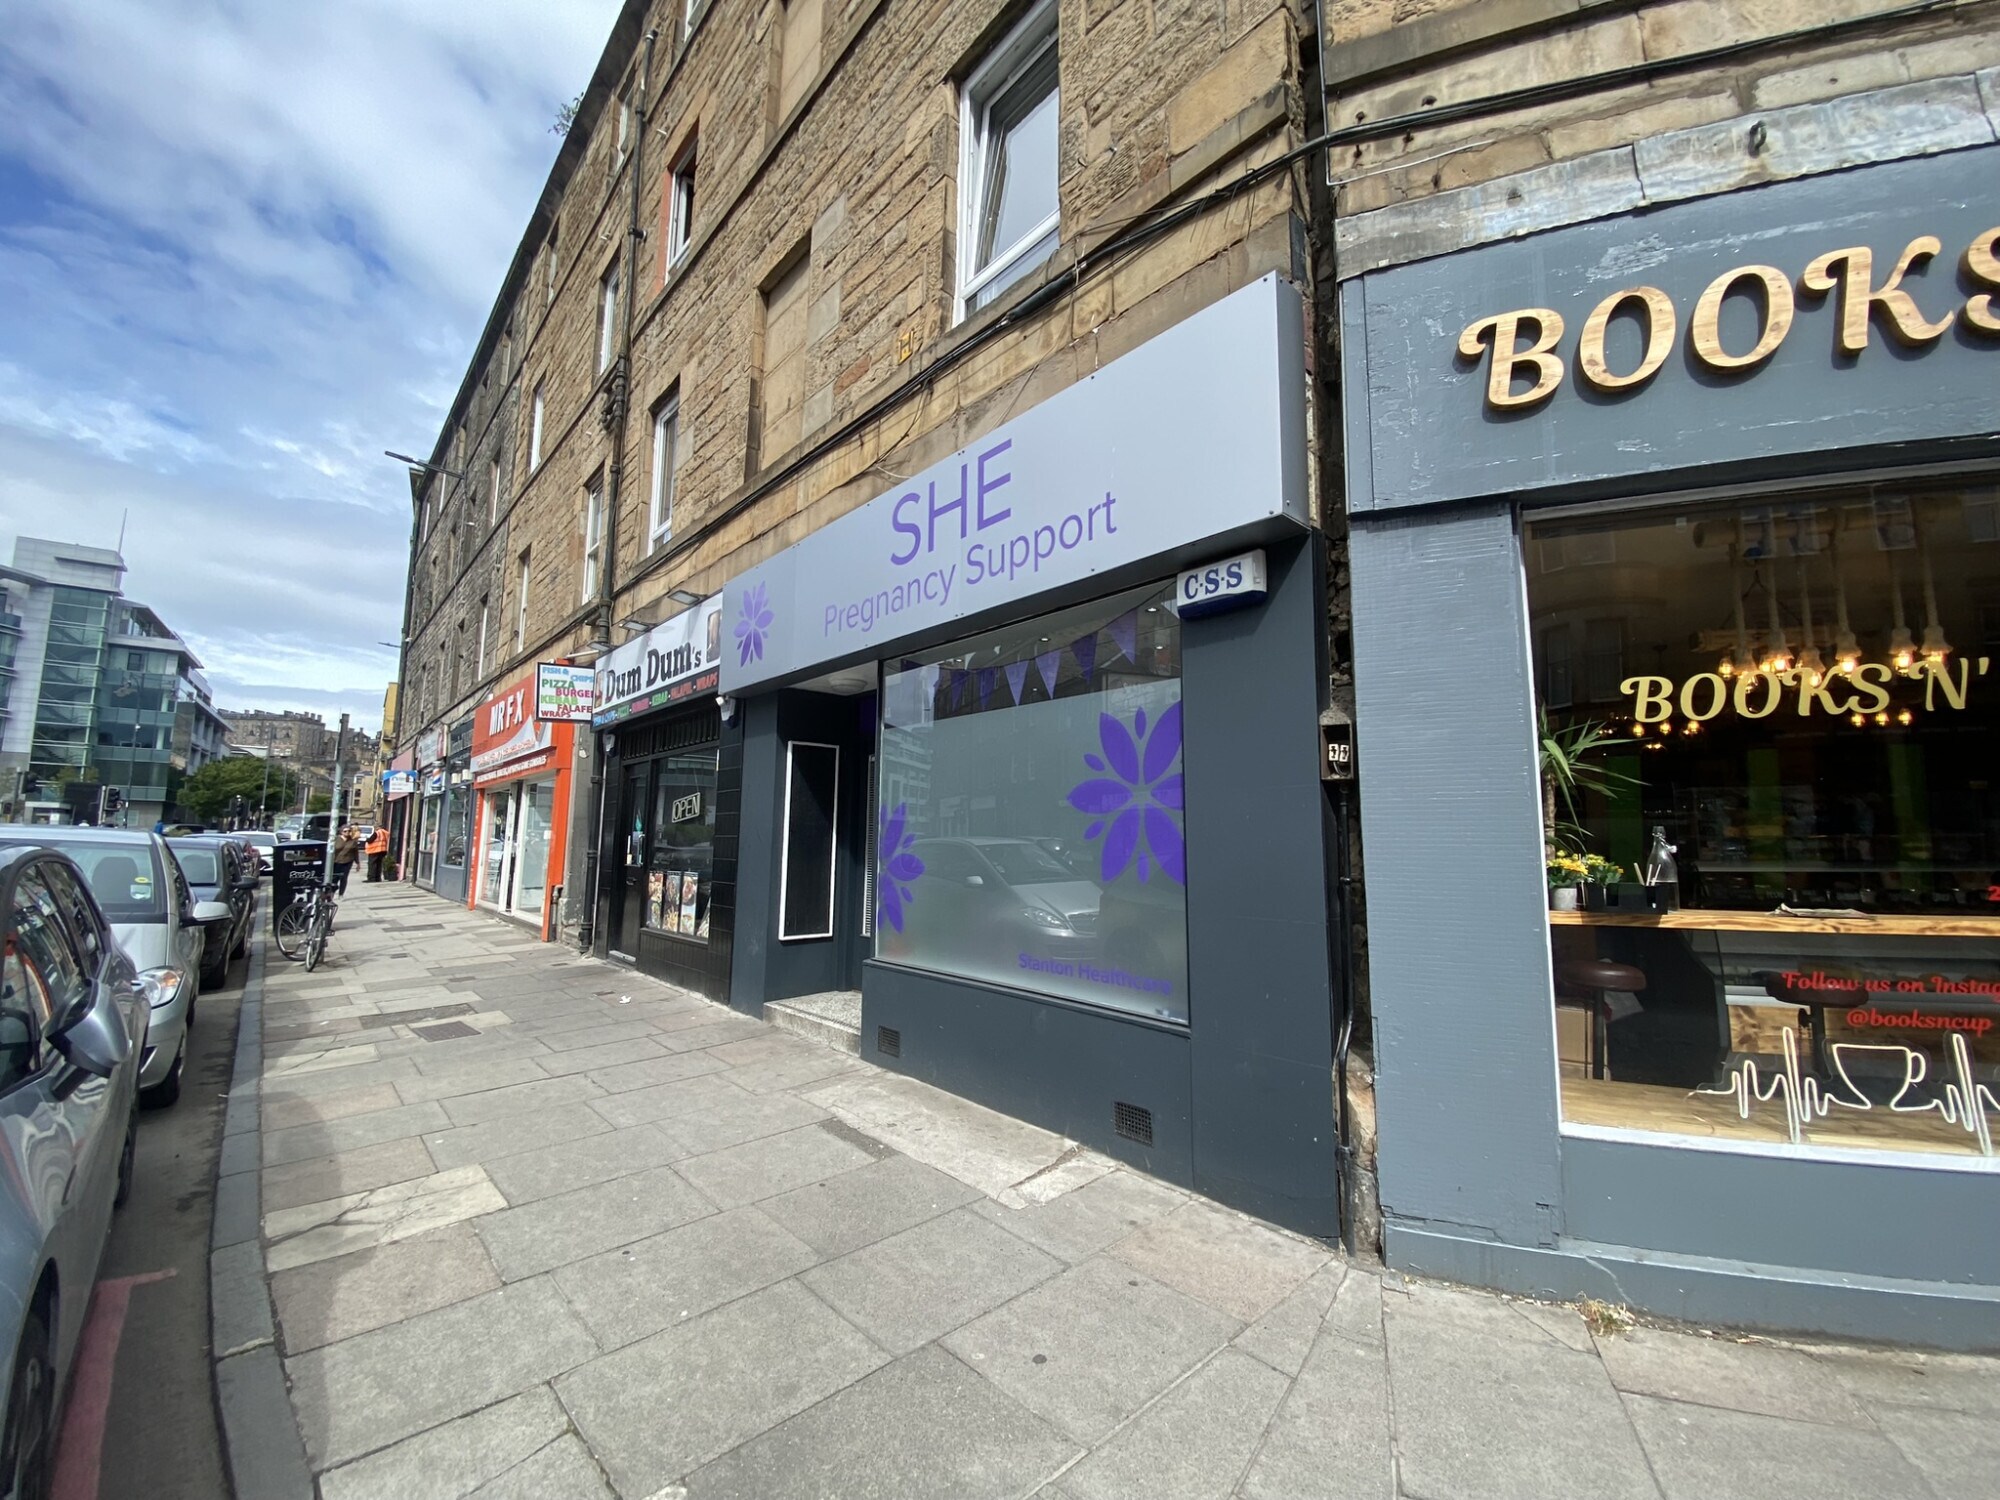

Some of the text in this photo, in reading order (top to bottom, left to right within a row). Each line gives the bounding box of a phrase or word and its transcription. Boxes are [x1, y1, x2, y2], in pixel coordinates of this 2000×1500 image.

[891, 438, 1012, 565] SHE
[824, 491, 1117, 637] Pregnancy Support
[542, 666, 561, 675] FISH
[604, 641, 702, 705] Dum Dum's
[541, 679, 575, 689] PIZZA
[1620, 663, 1892, 723] BOOKS
[541, 695, 578, 706] KEBAB
[541, 710, 571, 718] WRAPS
[674, 796, 699, 820] OPEN
[1018, 952, 1073, 977] Stanton
[1781, 971, 1860, 991] Follow
[1865, 979, 1891, 992] us
[1897, 980, 1926, 993] on
[1845, 1007, 1994, 1039] @booksncup
